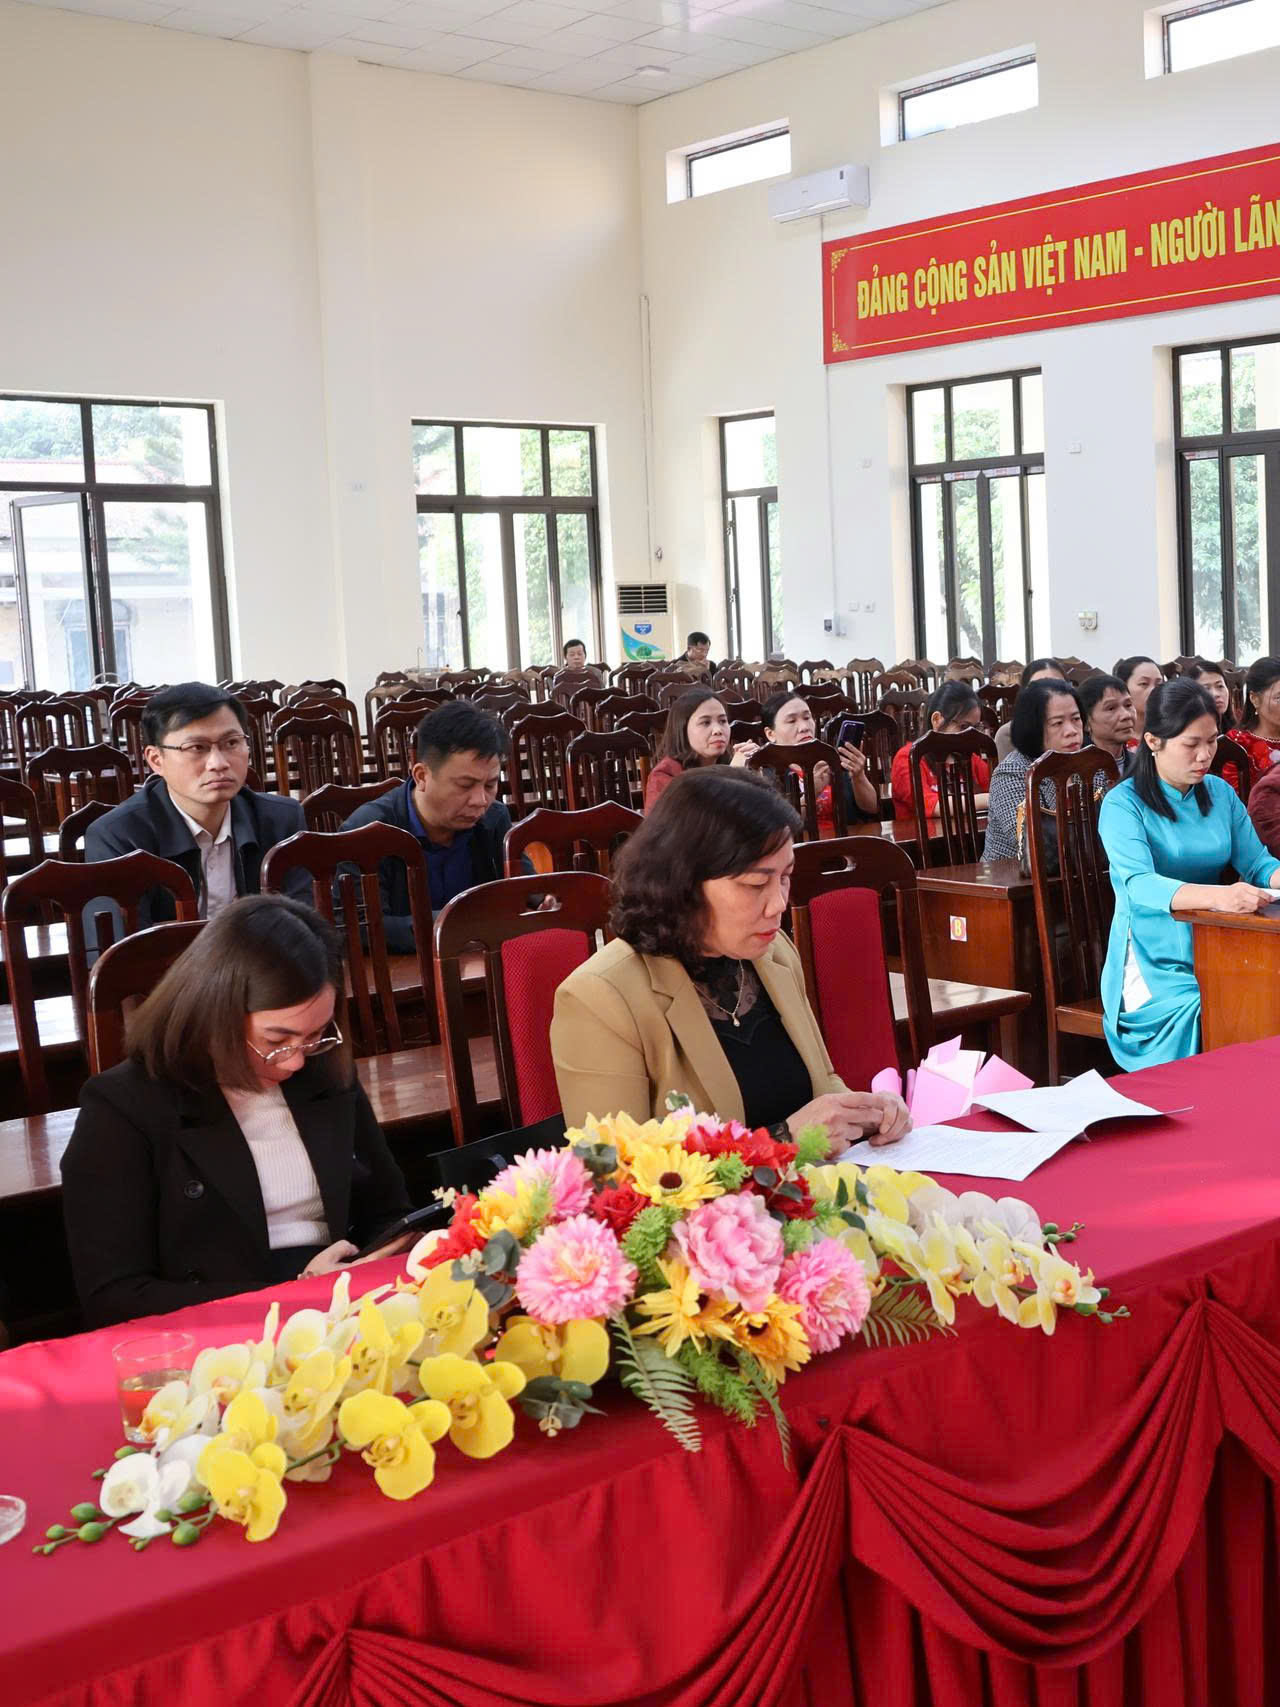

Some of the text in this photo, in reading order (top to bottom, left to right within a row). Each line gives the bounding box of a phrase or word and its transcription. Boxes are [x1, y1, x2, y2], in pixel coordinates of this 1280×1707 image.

[858, 265, 908, 318] ĐẢNG
[914, 257, 967, 314] CỘNG
[974, 239, 1017, 296] SẢN
[1022, 234, 1067, 296] VIỆT
[1074, 230, 1127, 280] NAM
[1134, 246, 1144, 257] -
[1151, 207, 1225, 267] NGƯỜI
